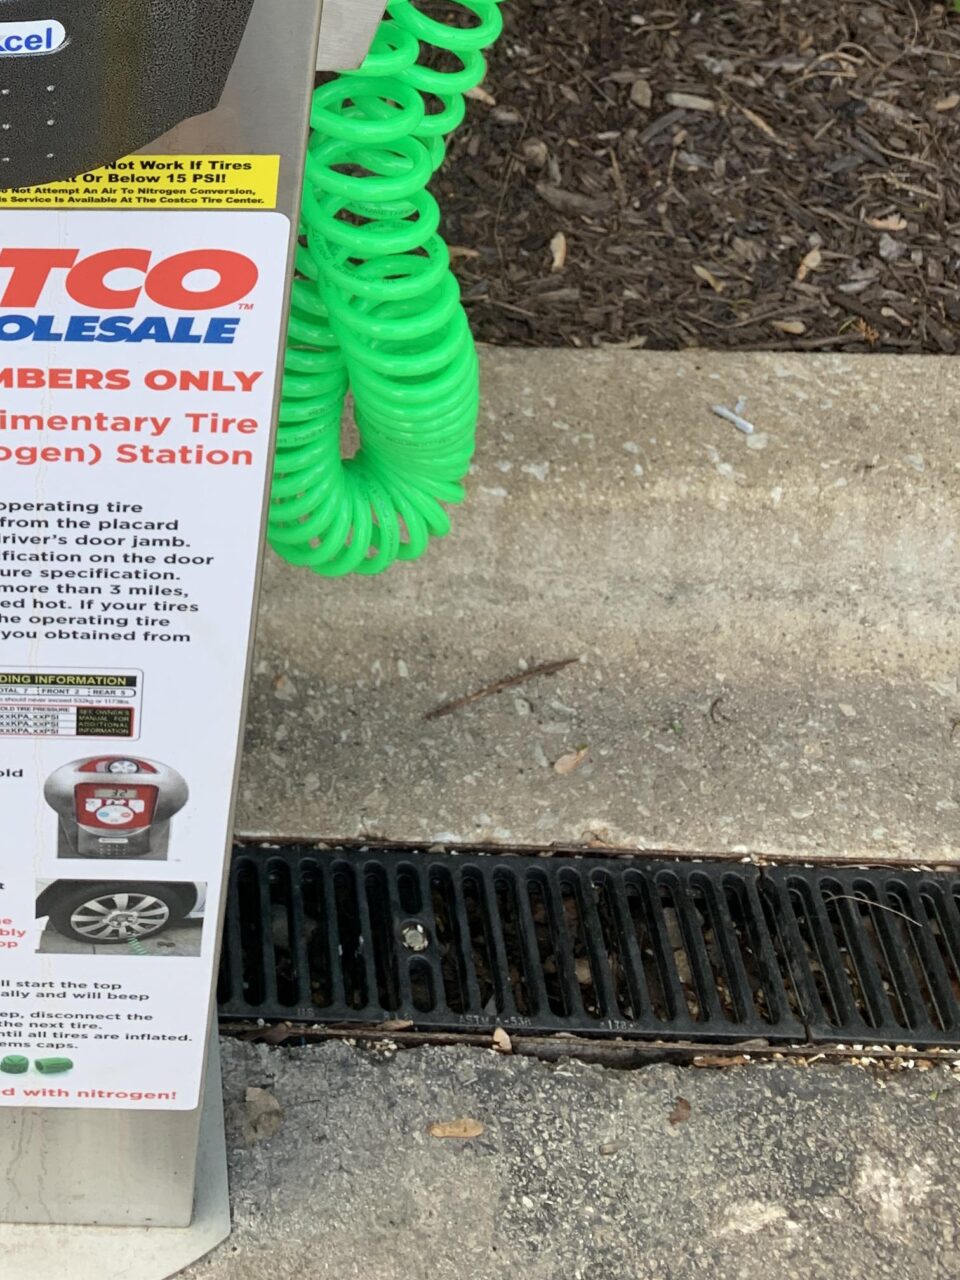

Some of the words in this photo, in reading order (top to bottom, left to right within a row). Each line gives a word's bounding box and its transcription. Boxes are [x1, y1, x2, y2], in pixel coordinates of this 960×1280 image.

[105, 161, 134, 170] Not
[141, 161, 184, 170] Work
[190, 161, 202, 170] If
[208, 161, 252, 170] Tires
[83, 174, 102, 183] Or
[108, 174, 160, 183] Below
[167, 174, 186, 183] 15
[192, 174, 226, 183] PSI!
[144, 369, 264, 393] ONLY
[184, 412, 259, 434] Tire
[116, 442, 253, 465] Station
[107, 501, 143, 512] tire
[0, 517, 48, 528] from
[57, 518, 91, 529] the
[99, 519, 179, 531] placard
[75, 535, 126, 546] door
[132, 536, 191, 548] jamb.
[89, 553, 115, 563] on
[123, 553, 156, 564] the
[164, 553, 214, 565] door
[40, 568, 180, 580] specification.
[1, 630, 37, 640] you
[45, 630, 135, 641] obtained
[143, 631, 191, 642] from
[35, 676, 126, 685] INFORMATION
[16, 980, 55, 988] start
[60, 981, 87, 989] the
[94, 982, 122, 991] top
[23, 1088, 69, 1097] with
[77, 1090, 176, 1101] nitrogen!
